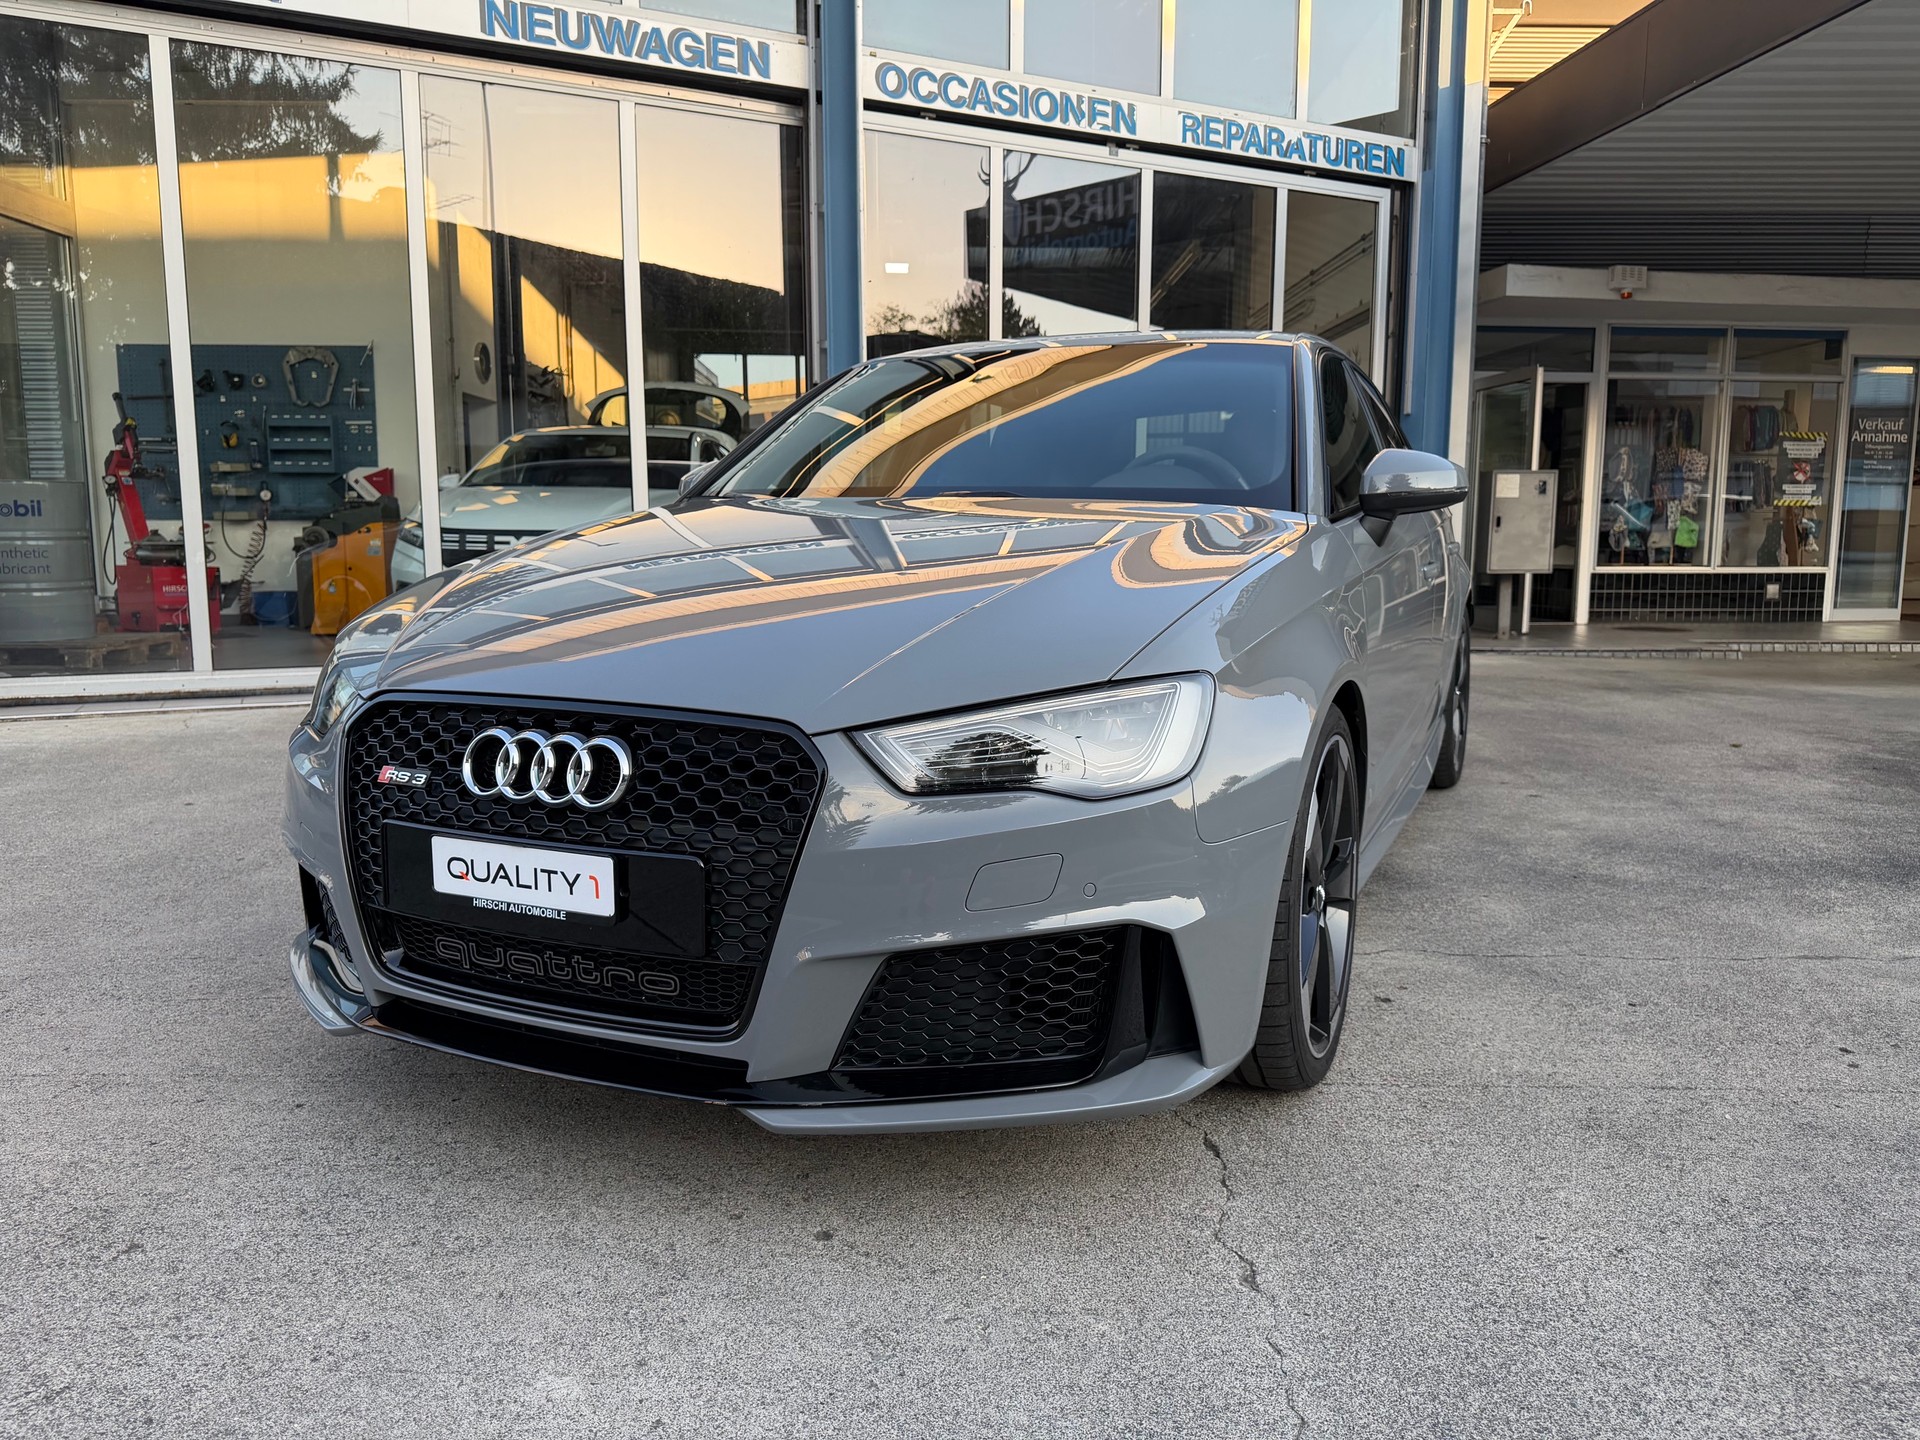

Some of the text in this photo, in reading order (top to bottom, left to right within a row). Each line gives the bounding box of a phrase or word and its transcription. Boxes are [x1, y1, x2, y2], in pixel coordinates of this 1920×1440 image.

[480, 0, 771, 80] NEUWAGEN
[875, 62, 1137, 135] OCCASIONEN
[1178, 110, 1405, 177] REPARATUREN
[1851, 430, 1908, 443] Annahme
[1858, 418, 1904, 430] Verkauf
[447, 856, 581, 896] QUALITY
[473, 898, 567, 921] HIRSCHI AUTOMOBILE
[434, 936, 680, 996] quattro
